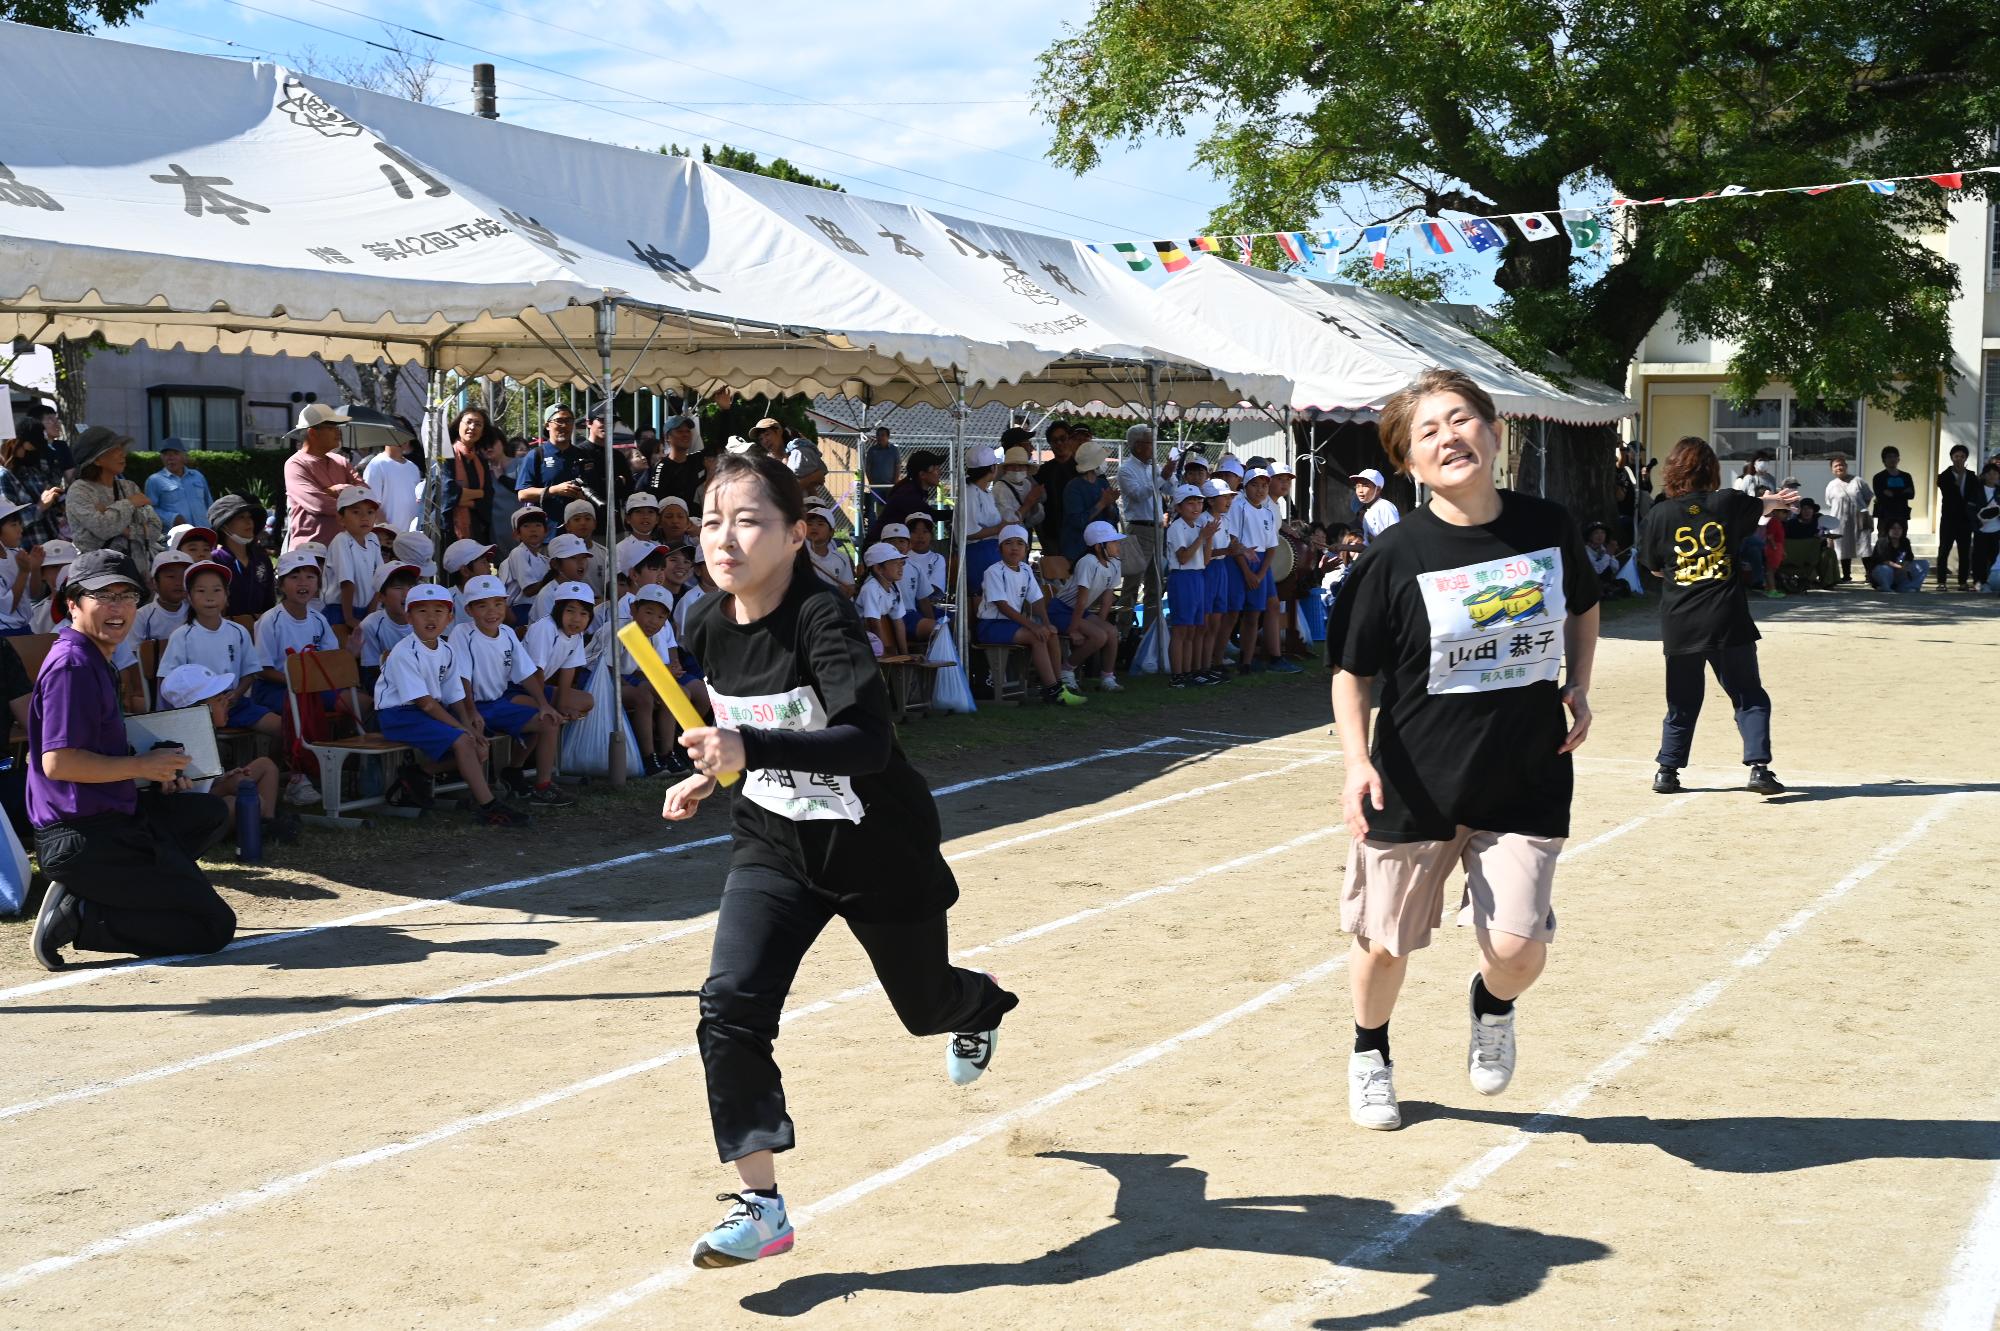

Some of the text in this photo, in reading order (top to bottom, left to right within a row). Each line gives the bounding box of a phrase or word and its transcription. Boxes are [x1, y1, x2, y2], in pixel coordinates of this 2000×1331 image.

[1673, 521, 1726, 557] 50
[1434, 573, 1471, 592] 歓迎
[1449, 629, 1556, 668] 山田 恭子
[1480, 667, 1527, 684] 阿久根市
[729, 698, 807, 723] 華の50歳組
